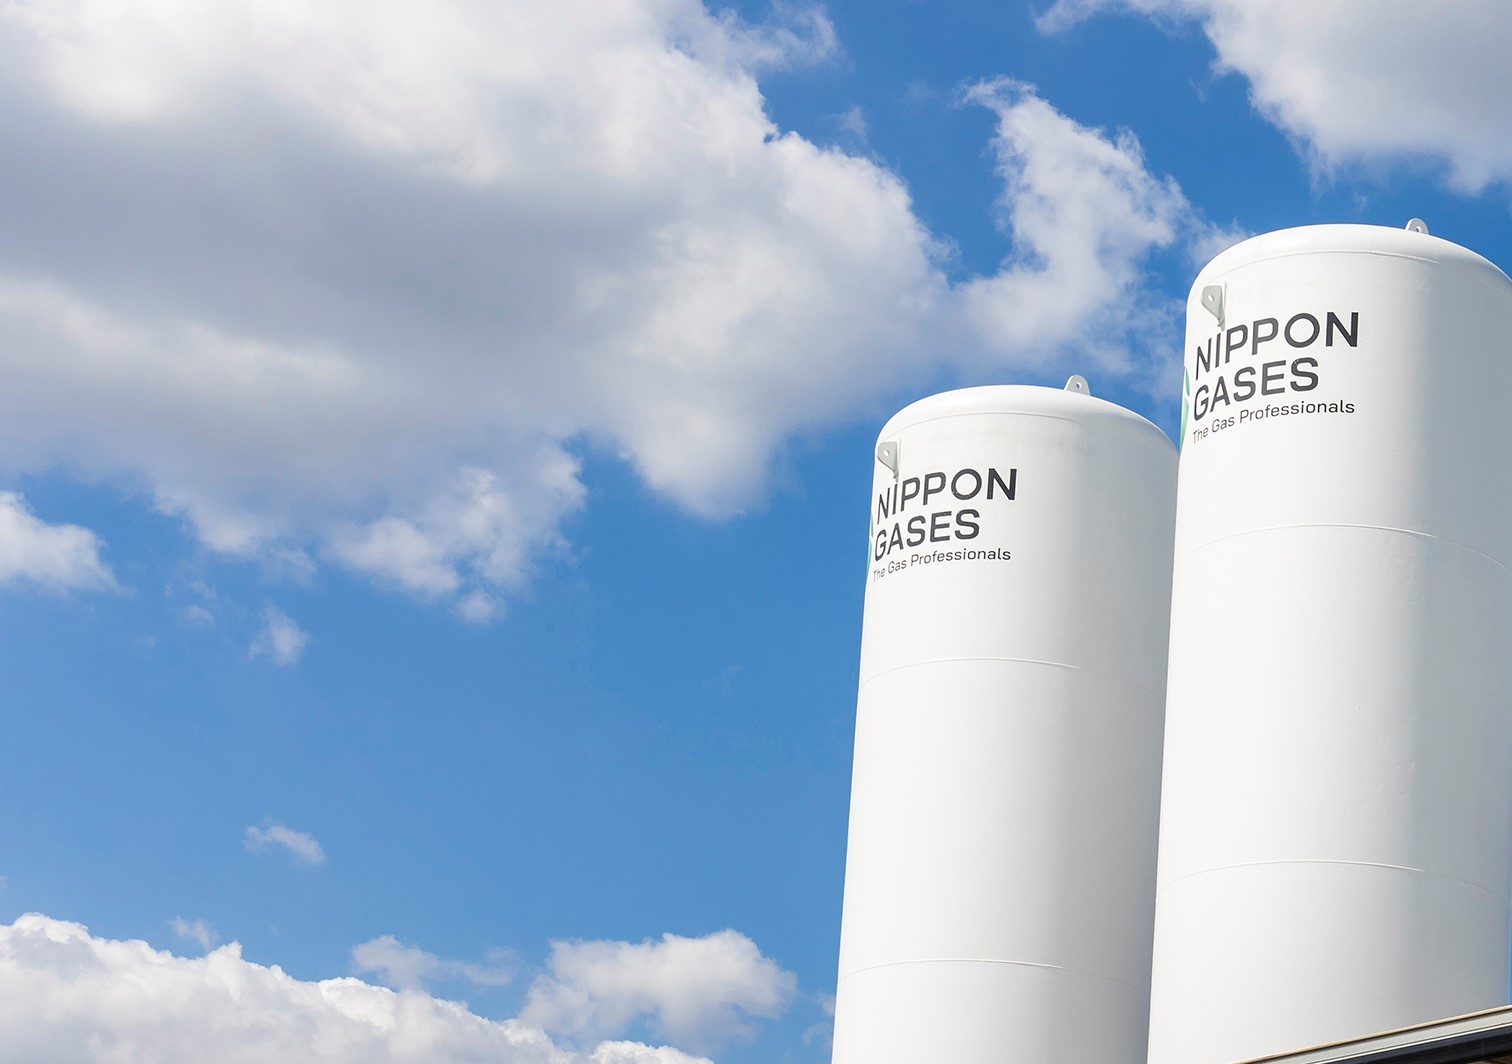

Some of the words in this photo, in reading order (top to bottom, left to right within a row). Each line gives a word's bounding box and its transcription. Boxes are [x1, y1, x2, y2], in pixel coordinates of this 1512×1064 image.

[1196, 312, 1358, 381] NIPPON
[1194, 357, 1319, 421] GASES
[1192, 426, 1208, 444] The
[1212, 417, 1235, 433] Gas
[1240, 400, 1355, 423] Professionals
[877, 468, 1017, 524] NIPPON
[875, 509, 980, 561] GASES
[888, 560, 907, 573] Gas
[910, 548, 1011, 566] Professionals
